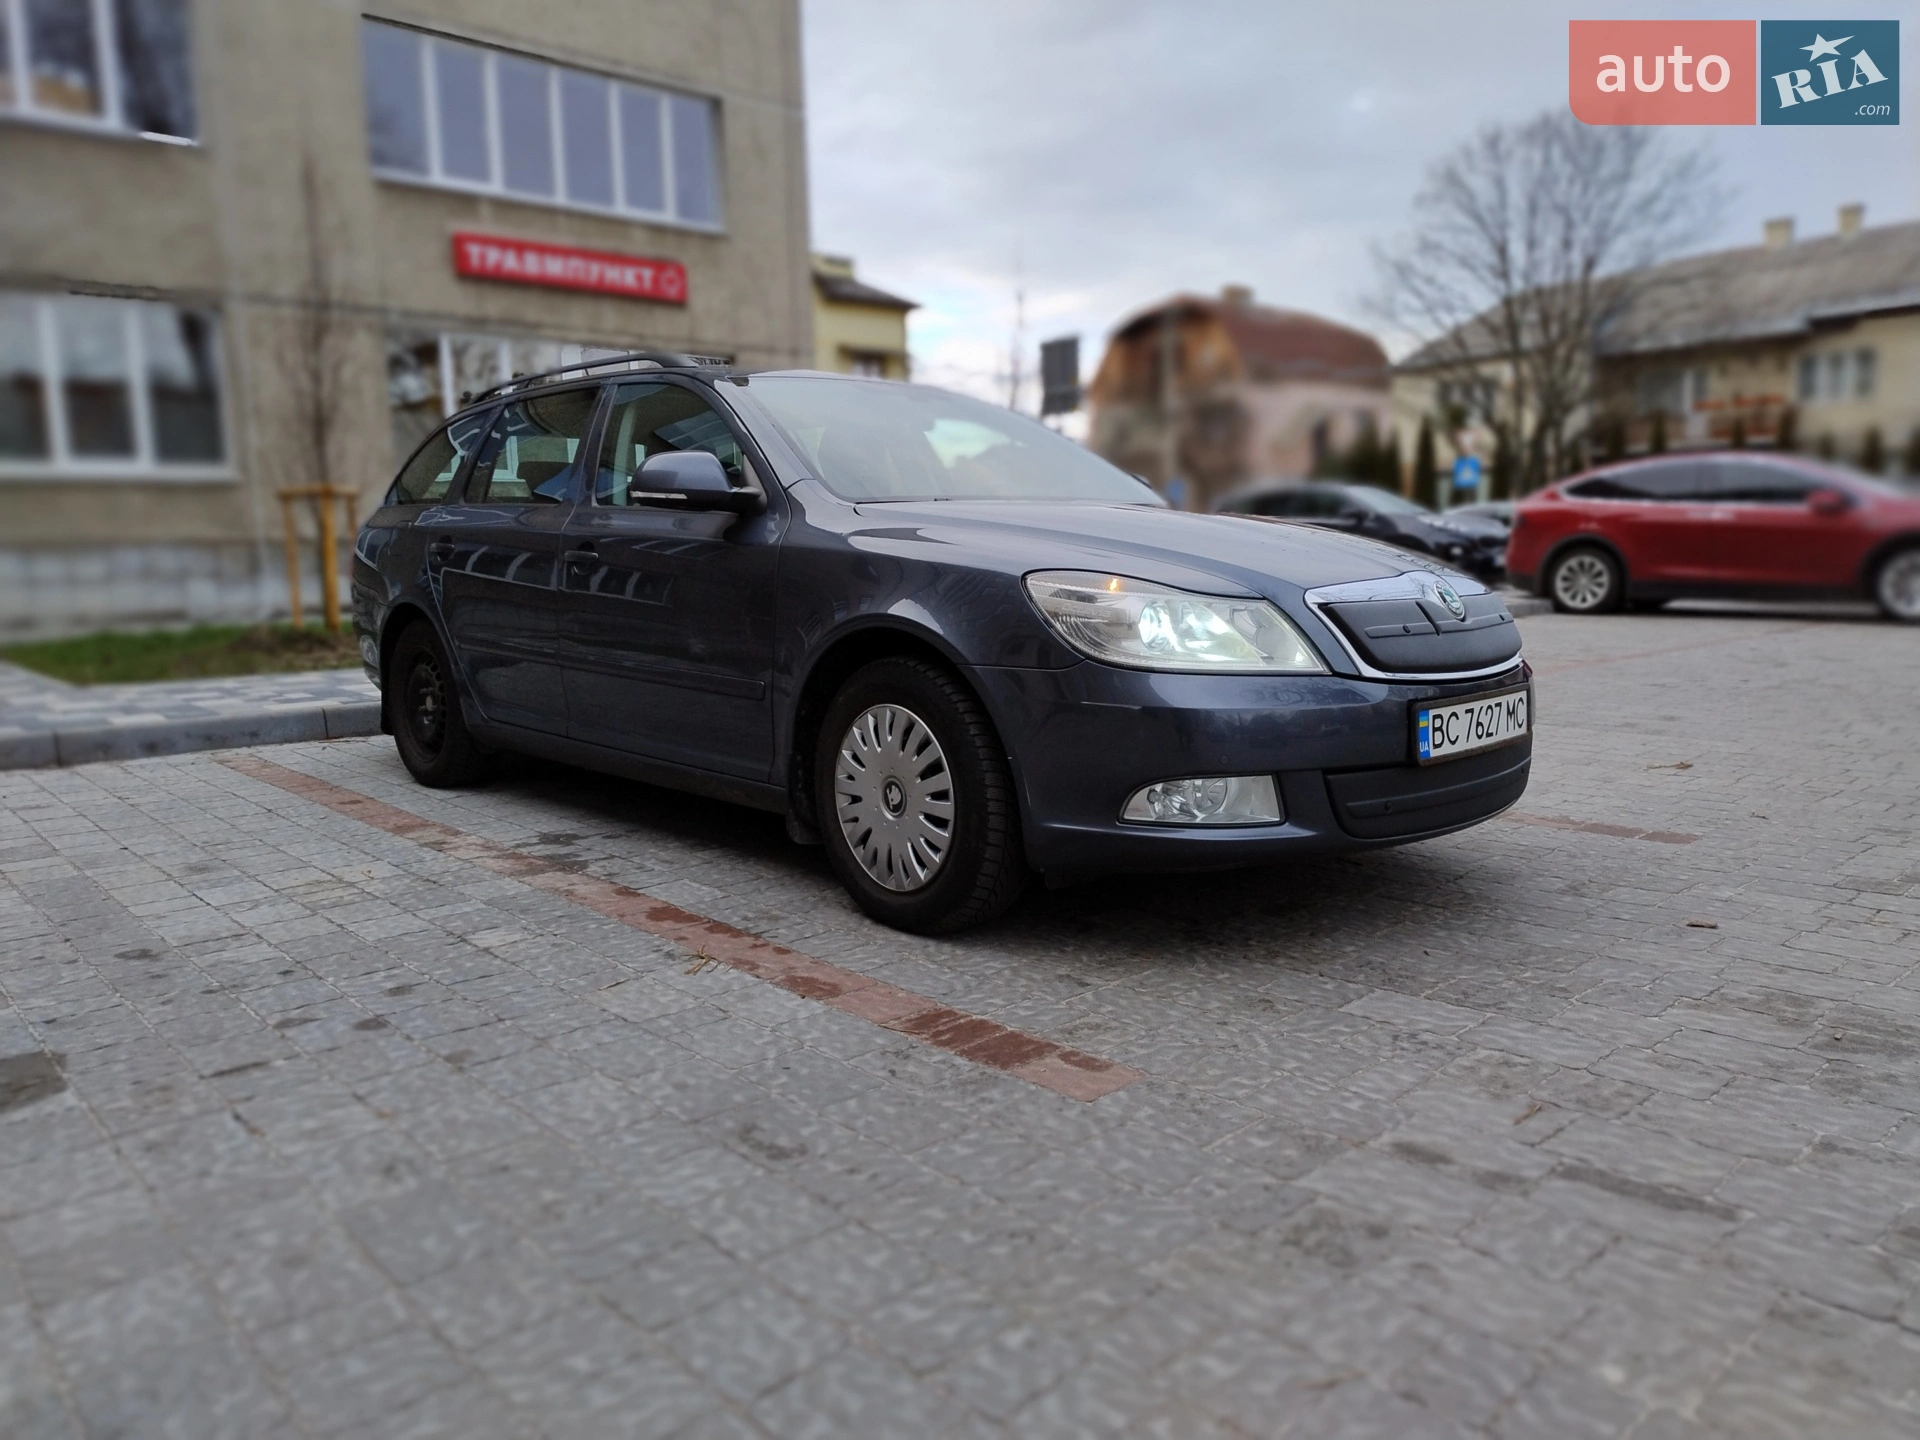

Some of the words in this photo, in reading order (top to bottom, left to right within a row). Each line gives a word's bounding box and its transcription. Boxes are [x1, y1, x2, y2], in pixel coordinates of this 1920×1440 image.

[465, 243, 654, 289] ТРАВМПУНКТ
[1432, 711, 1459, 749] BC
[1464, 701, 1502, 743] 7627
[1506, 697, 1525, 732] MC
[1419, 740, 1429, 753] UA
